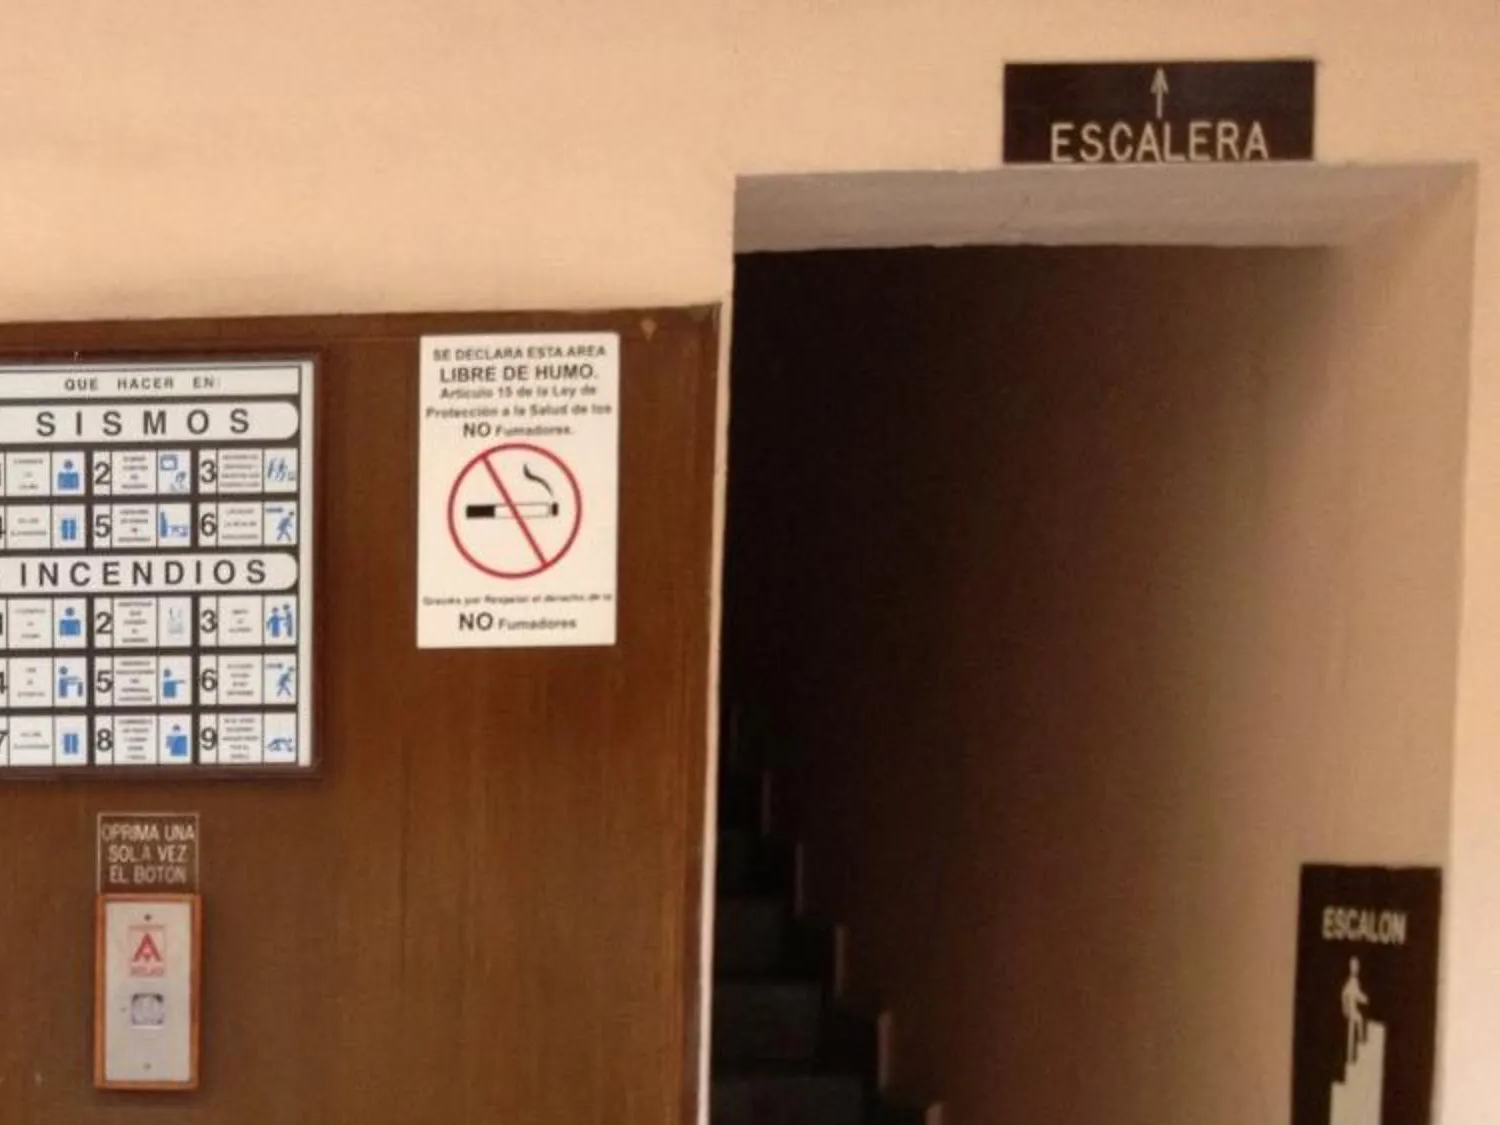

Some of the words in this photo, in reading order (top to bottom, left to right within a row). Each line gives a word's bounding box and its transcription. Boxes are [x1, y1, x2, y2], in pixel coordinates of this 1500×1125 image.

[1050, 120, 1269, 163] ESCALERA
[433, 349, 451, 362] SE
[455, 347, 523, 360] DECLARA
[527, 346, 563, 359] ESTA
[566, 345, 606, 358] AREA
[64, 376, 99, 392] QUE
[117, 375, 174, 391] HACER
[439, 367, 496, 383] LIBRE
[503, 366, 529, 382] DE
[535, 363, 599, 381] HUMO.
[516, 386, 533, 397] de
[536, 386, 548, 397] la
[552, 385, 577, 398] Ley
[580, 384, 597, 395] de
[529, 403, 567, 416] Salud
[571, 403, 588, 414] de
[36, 408, 250, 437] SISMOS
[463, 421, 491, 437] NO
[94, 461, 111, 485] 2
[201, 460, 216, 483] 3
[94, 514, 112, 538] 5
[201, 513, 217, 537] 6
[20, 559, 266, 587] INCENDIOS
[96, 611, 112, 634] 2
[200, 609, 217, 633] 3
[458, 611, 494, 632] NO
[498, 617, 577, 631] Fumadores
[96, 670, 113, 693] 5
[201, 669, 217, 692] 6
[96, 728, 113, 751] 8
[200, 727, 217, 751] 9
[102, 823, 159, 841] OPRIMA
[164, 823, 195, 842] UNA
[108, 845, 152, 863] SOLA
[157, 845, 188, 863] VEZ
[109, 866, 129, 884] EL
[133, 864, 187, 885] BOTON
[1322, 906, 1407, 945] ESCALON
